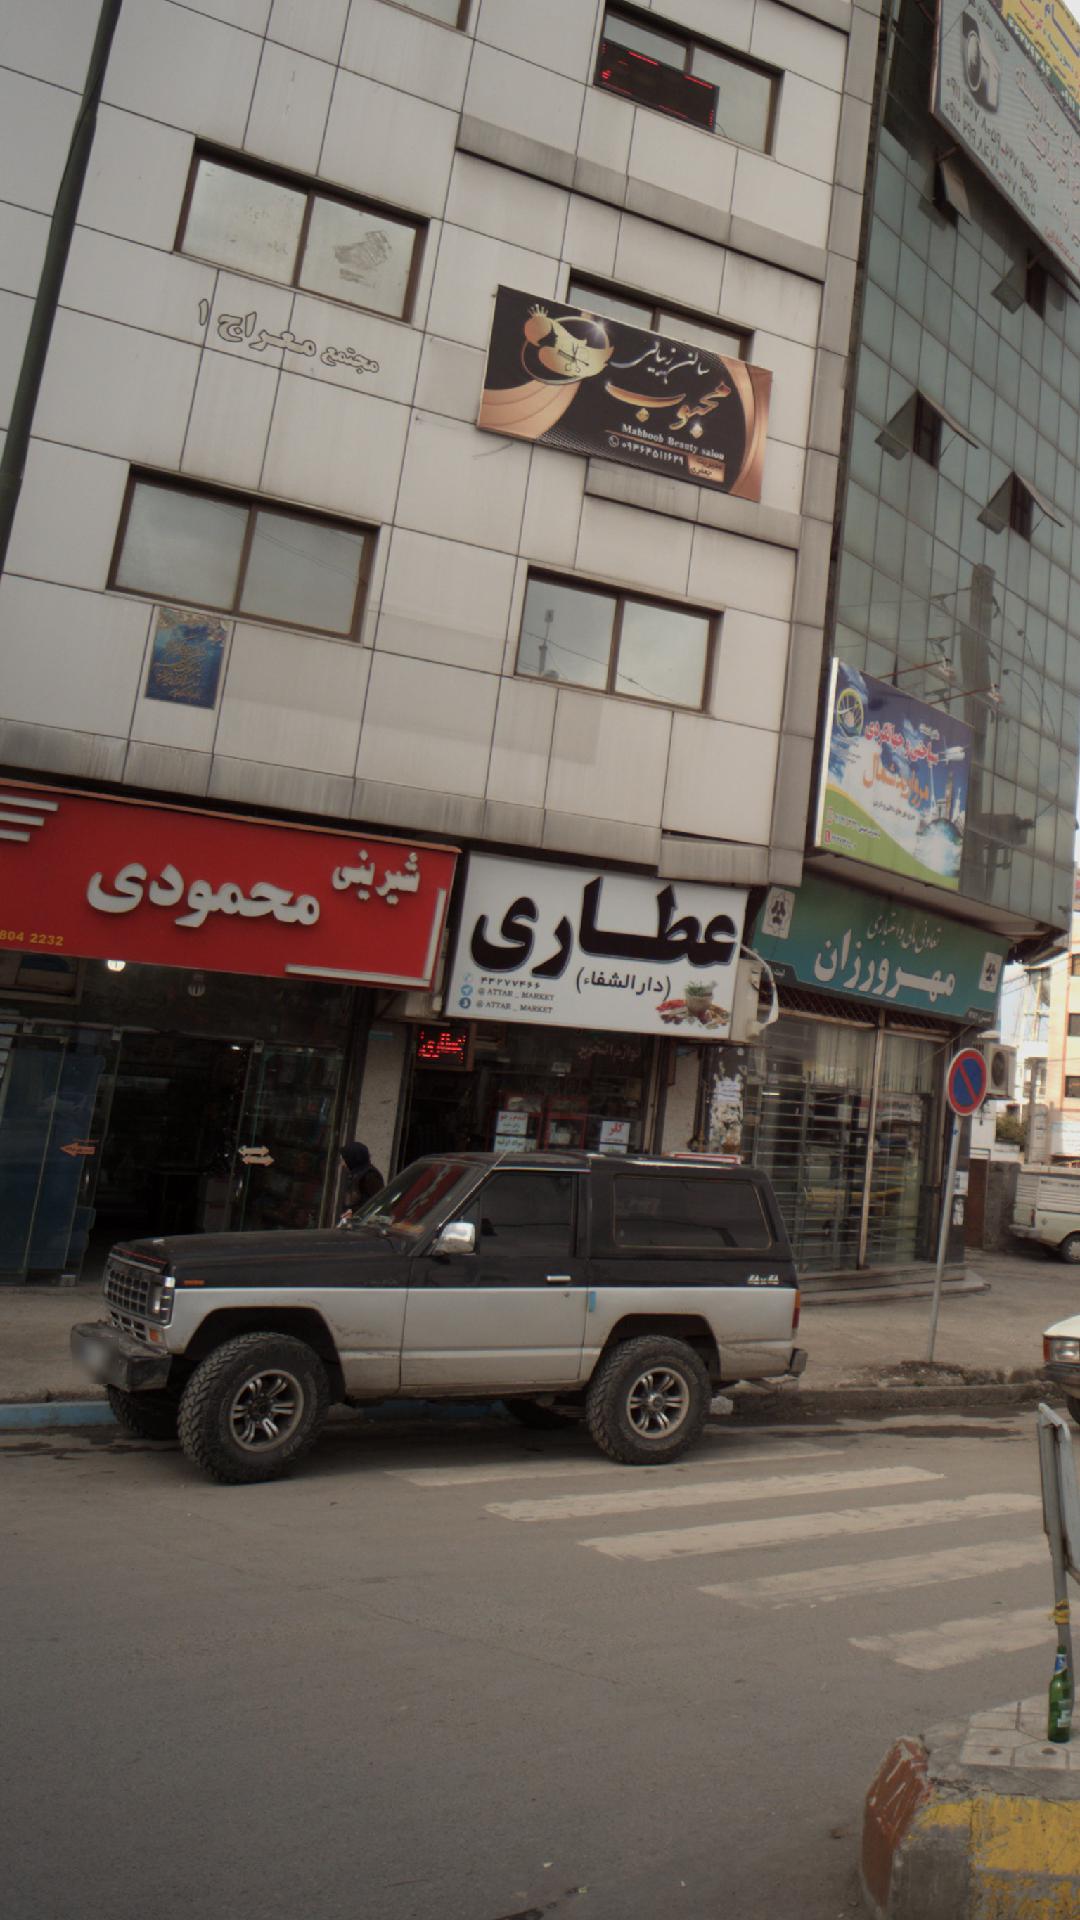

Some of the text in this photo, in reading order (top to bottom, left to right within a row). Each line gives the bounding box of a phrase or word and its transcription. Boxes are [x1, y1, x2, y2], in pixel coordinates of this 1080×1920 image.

[217, 311, 316, 357] معراج
[321, 347, 379, 374] مجتمع
[609, 341, 677, 384] زیبایی
[604, 381, 731, 439] محبوب
[621, 423, 664, 443] Mahboob
[667, 436, 699, 454] Beauty
[86, 863, 320, 928] محمودی
[331, 850, 420, 904] شیرینی
[30, 932, 65, 947] 2232
[471, 876, 739, 979] عطاری
[814, 928, 956, 1003] مهرورزان
